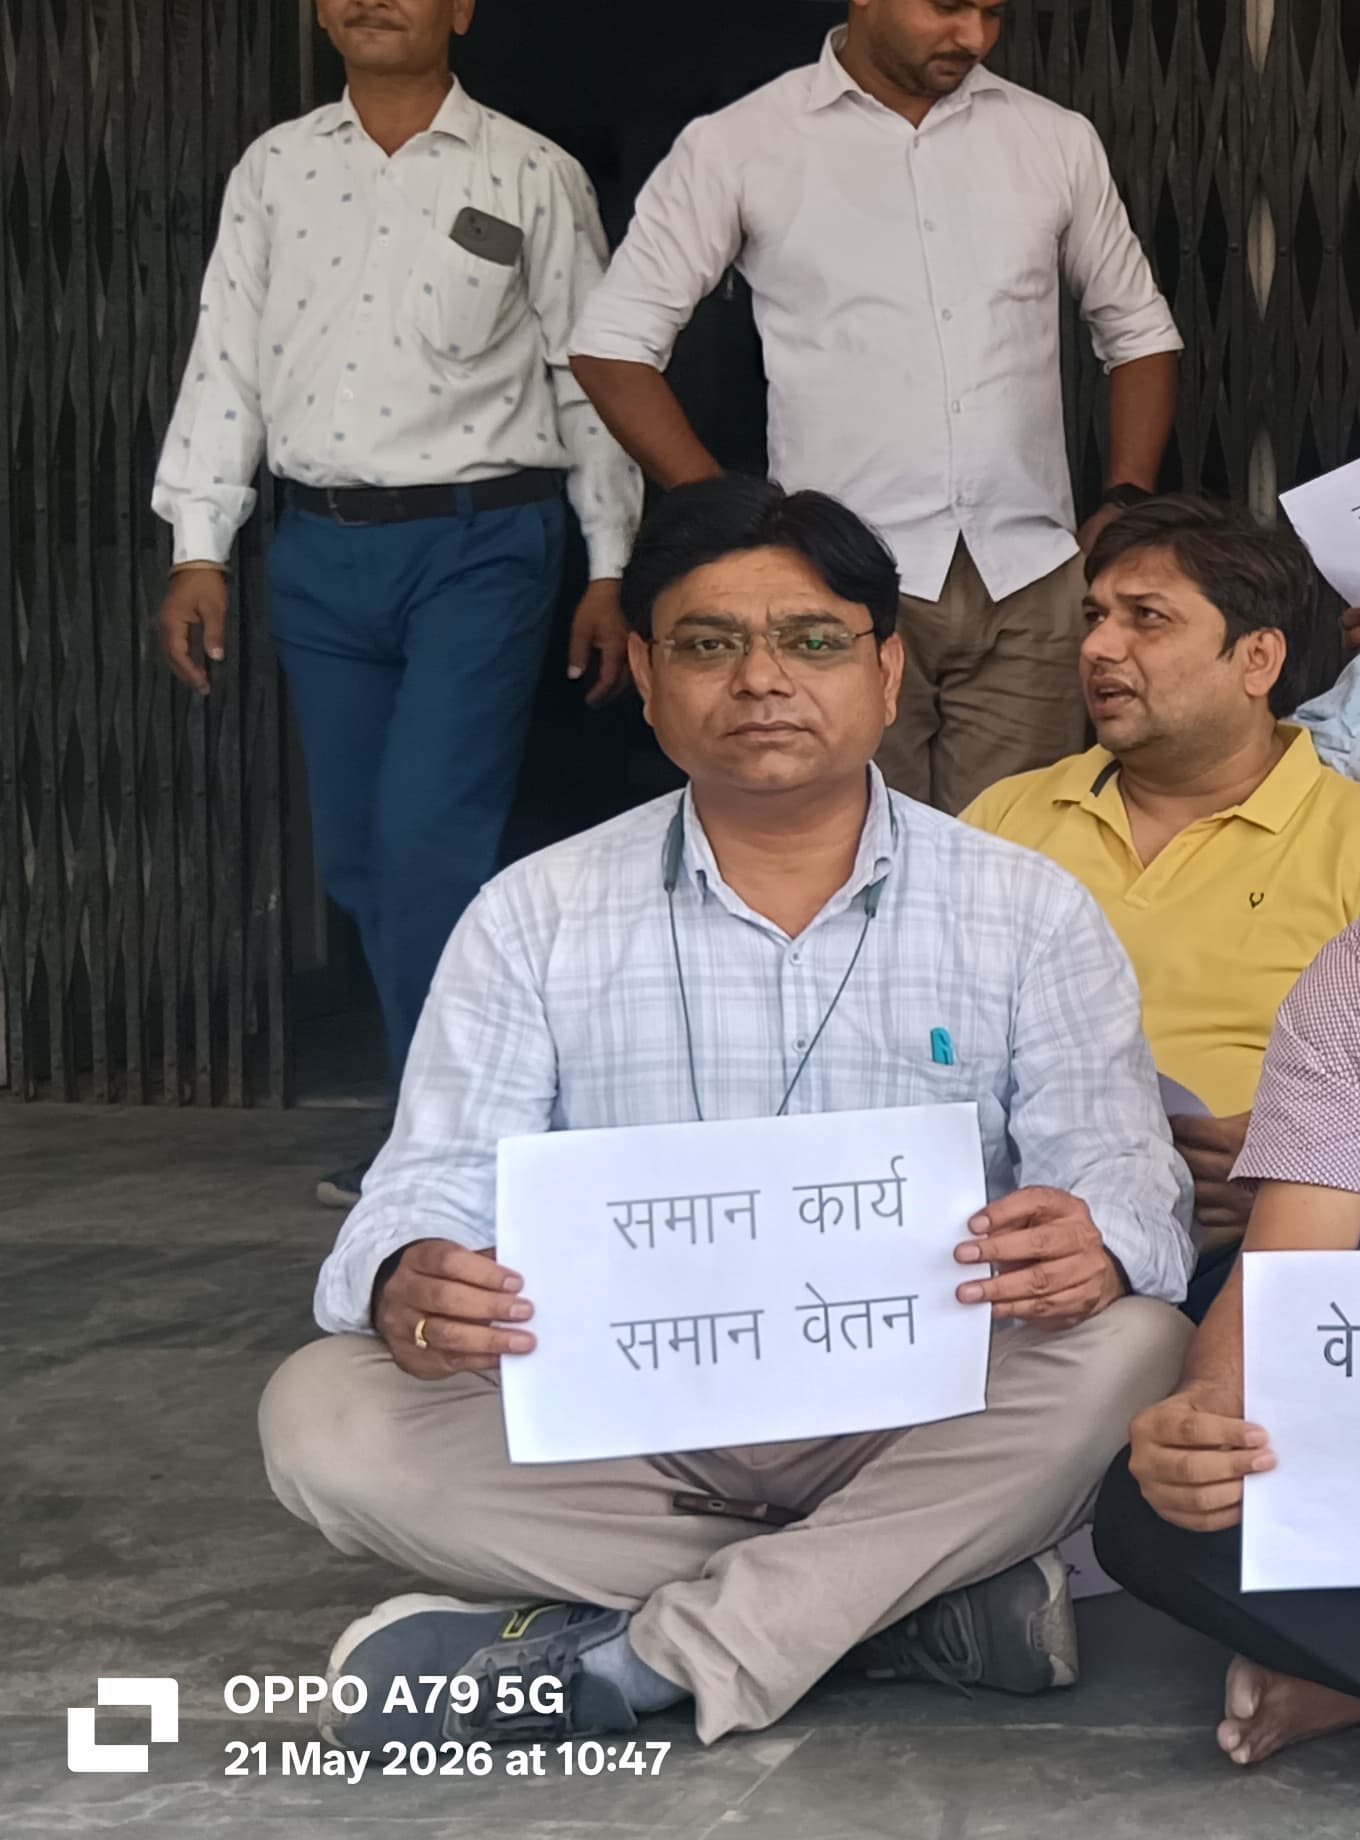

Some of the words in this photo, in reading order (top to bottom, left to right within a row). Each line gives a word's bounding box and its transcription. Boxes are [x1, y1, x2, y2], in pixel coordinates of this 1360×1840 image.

[605, 1188, 762, 1251] समान
[792, 1154, 908, 1236] कार्य
[608, 1308, 766, 1372] समान
[794, 1281, 920, 1355] वेतन
